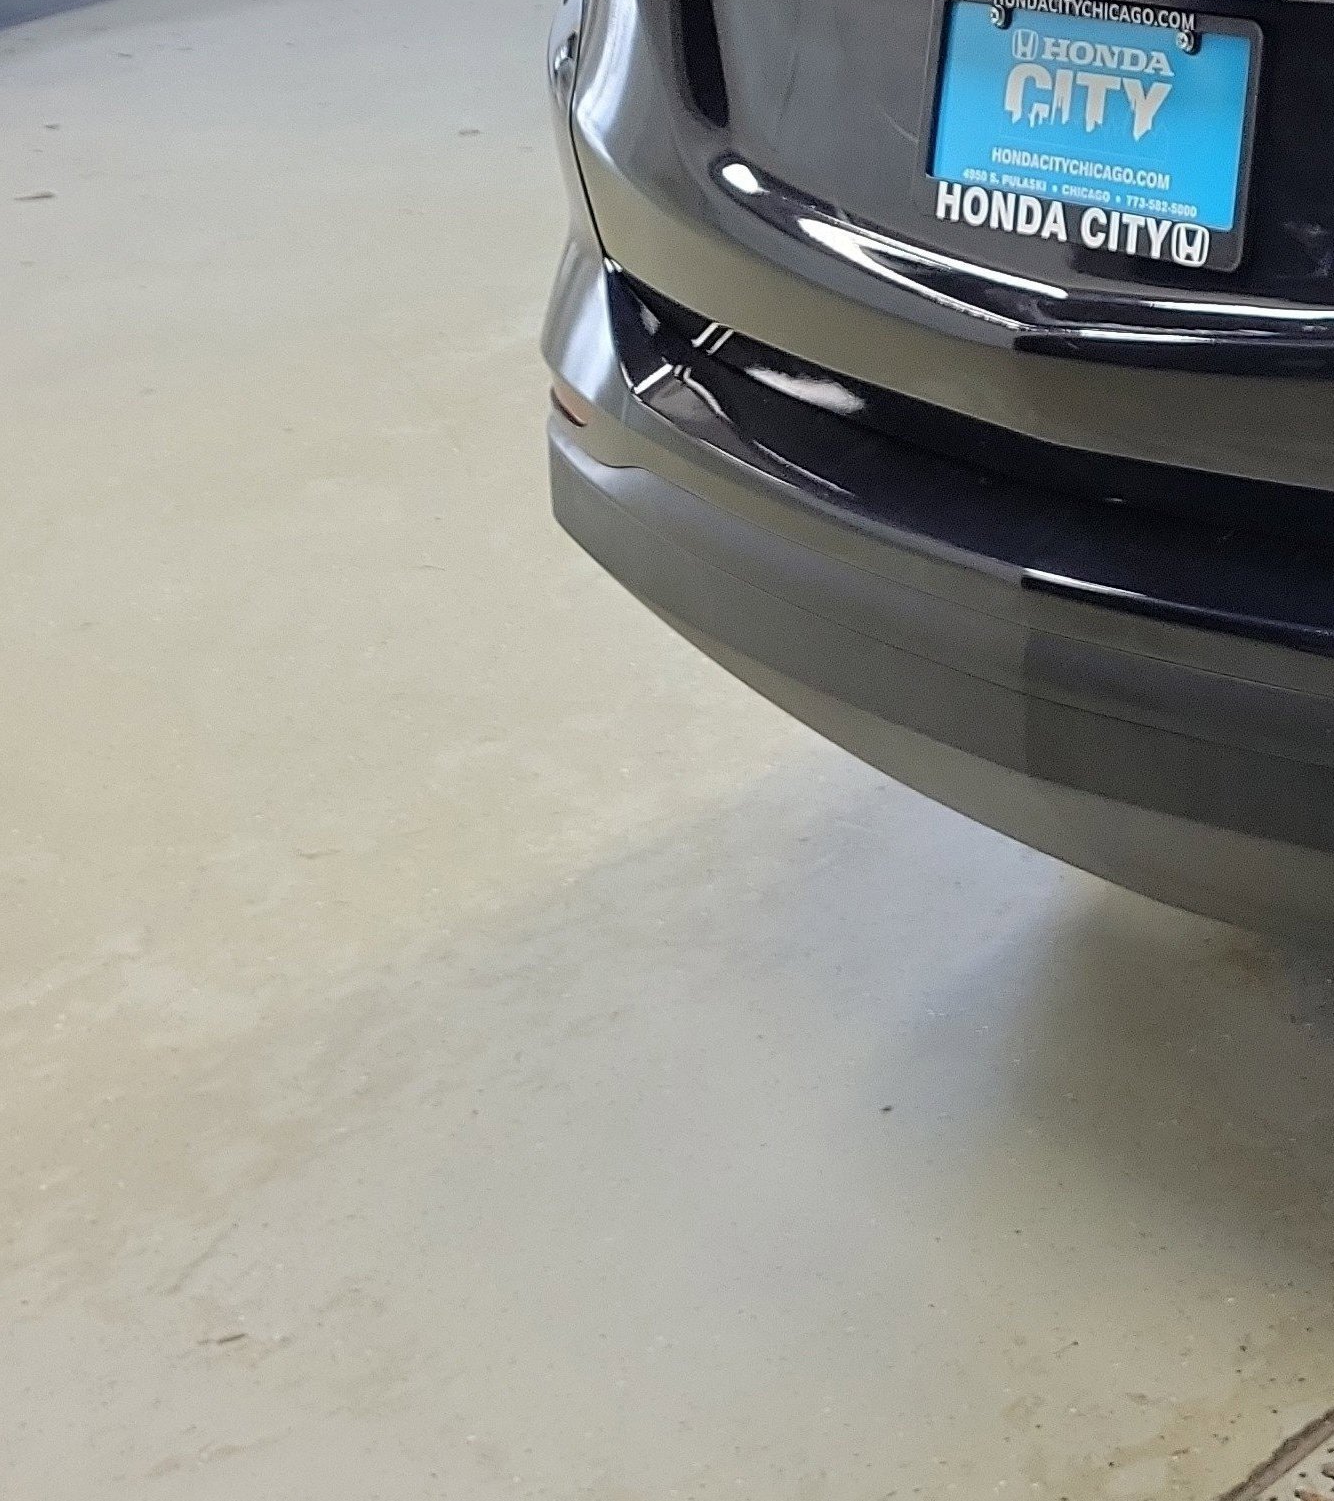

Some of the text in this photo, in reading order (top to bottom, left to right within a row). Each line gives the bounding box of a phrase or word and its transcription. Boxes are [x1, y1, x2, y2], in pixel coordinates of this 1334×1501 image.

[1041, 37, 1175, 77] HONDA
[1004, 63, 1173, 142] CITY
[991, 146, 1170, 190] HONDACITYCHICAGO.COM
[1002, 174, 1047, 192] PULASKI
[1061, 184, 1111, 203] CHICAGO
[936, 180, 1068, 242] HONDA
[1080, 207, 1172, 259] CITY
